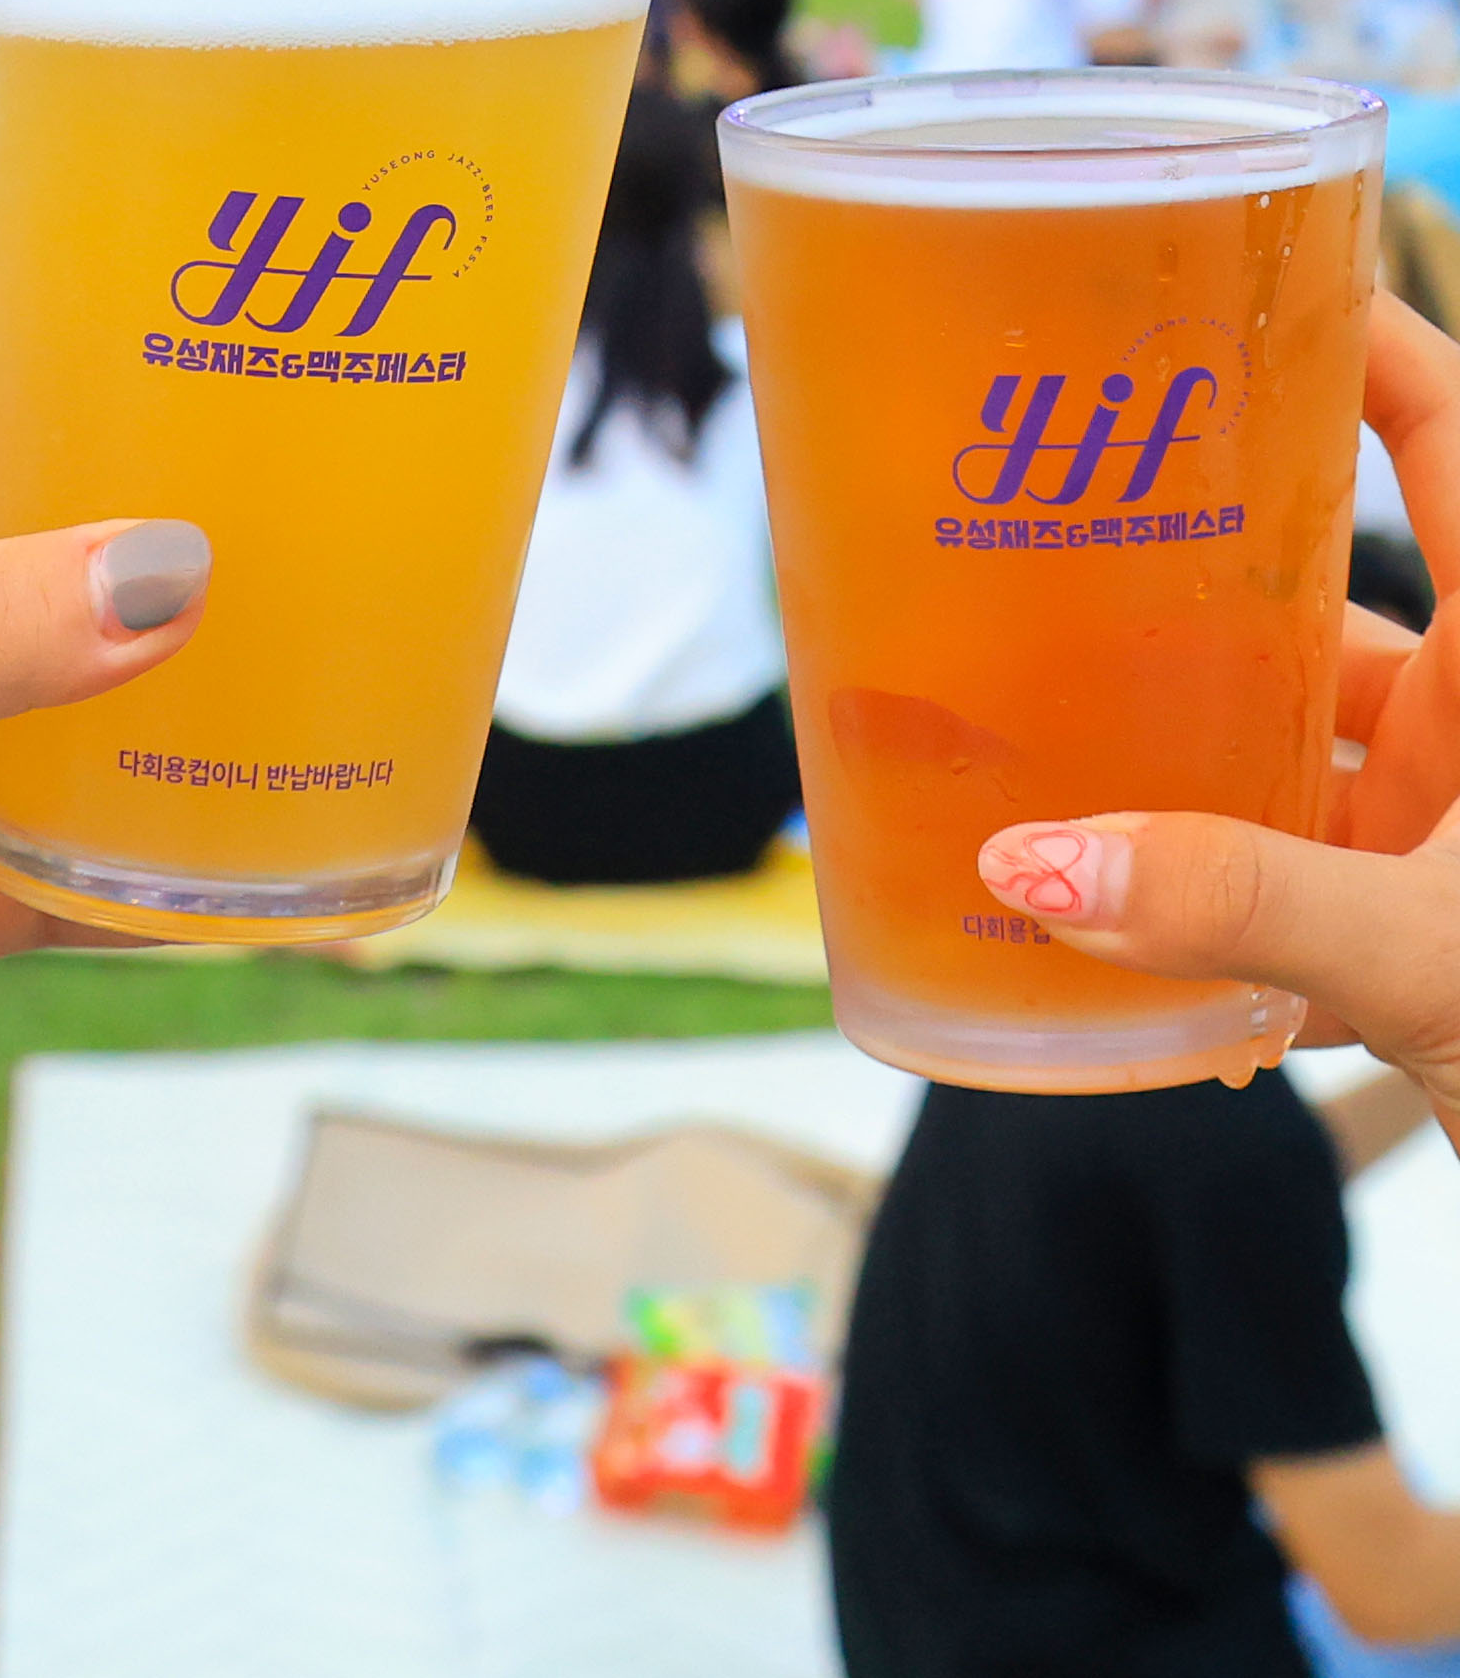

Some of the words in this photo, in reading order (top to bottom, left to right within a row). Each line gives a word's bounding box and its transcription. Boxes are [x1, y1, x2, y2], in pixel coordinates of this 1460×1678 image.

[362, 150, 435, 191] YUSEONG
[142, 332, 467, 384] 유성재즈&맥주페스타
[934, 504, 1246, 550] 유성재즈&맥주페스타
[119, 749, 259, 790] 다회용컵이니
[267, 758, 394, 791] 반납바랍니다
